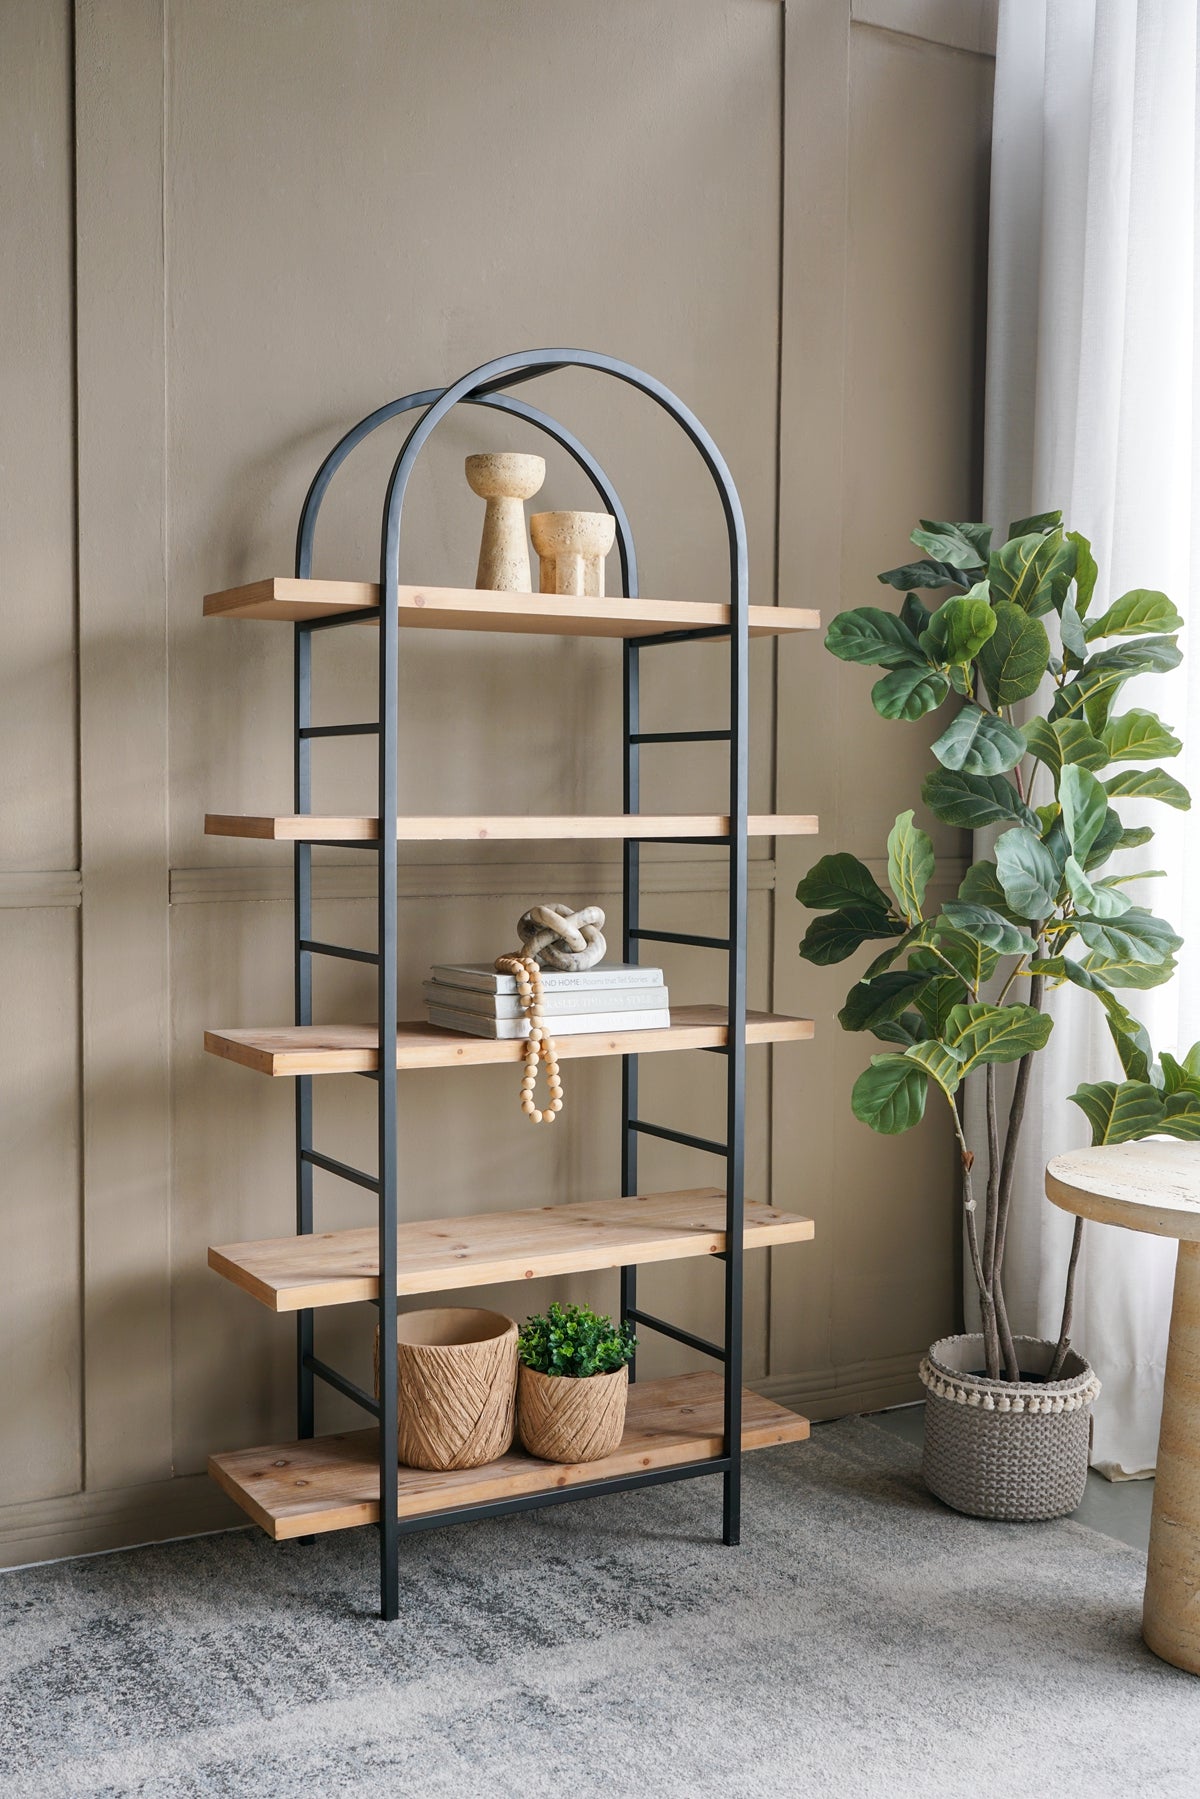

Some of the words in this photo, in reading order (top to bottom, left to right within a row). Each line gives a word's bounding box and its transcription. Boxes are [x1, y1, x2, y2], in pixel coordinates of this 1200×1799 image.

[583, 977, 604, 985] Rooms
[605, 976, 616, 985] that
[617, 975, 627, 984] Tell
[628, 975, 648, 984] Stories
